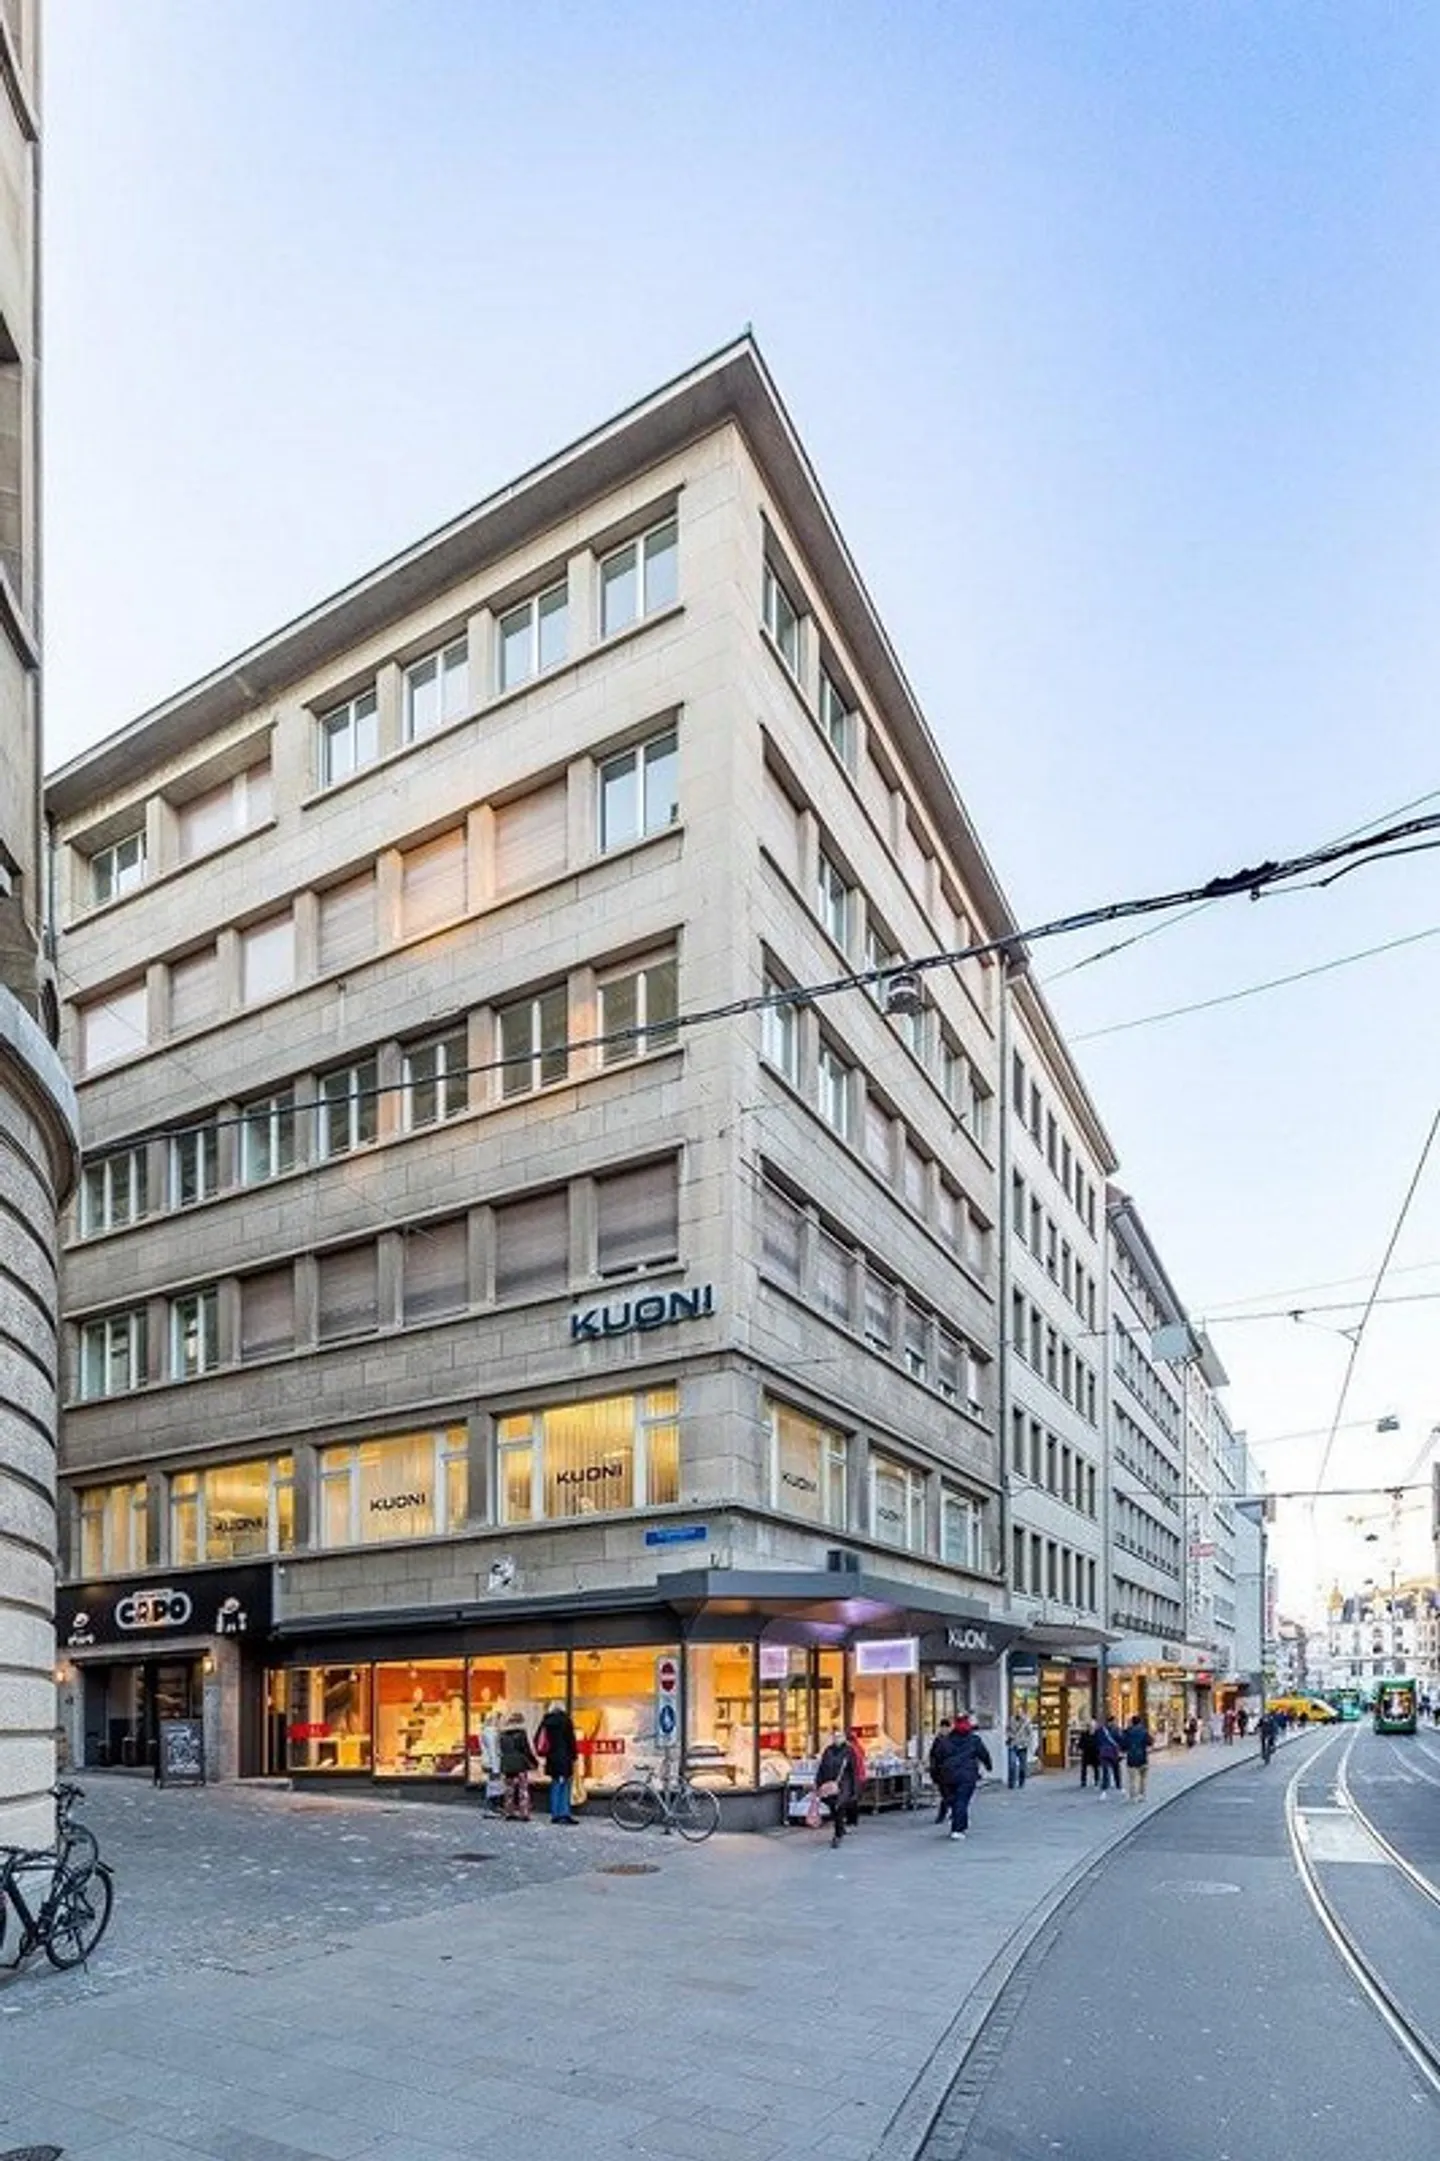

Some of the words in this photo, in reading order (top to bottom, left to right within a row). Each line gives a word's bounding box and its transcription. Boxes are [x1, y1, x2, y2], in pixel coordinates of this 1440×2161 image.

[570, 1283, 713, 1340] KUONI
[556, 1464, 623, 1485] KUONI
[370, 1493, 426, 1512] KUONI
